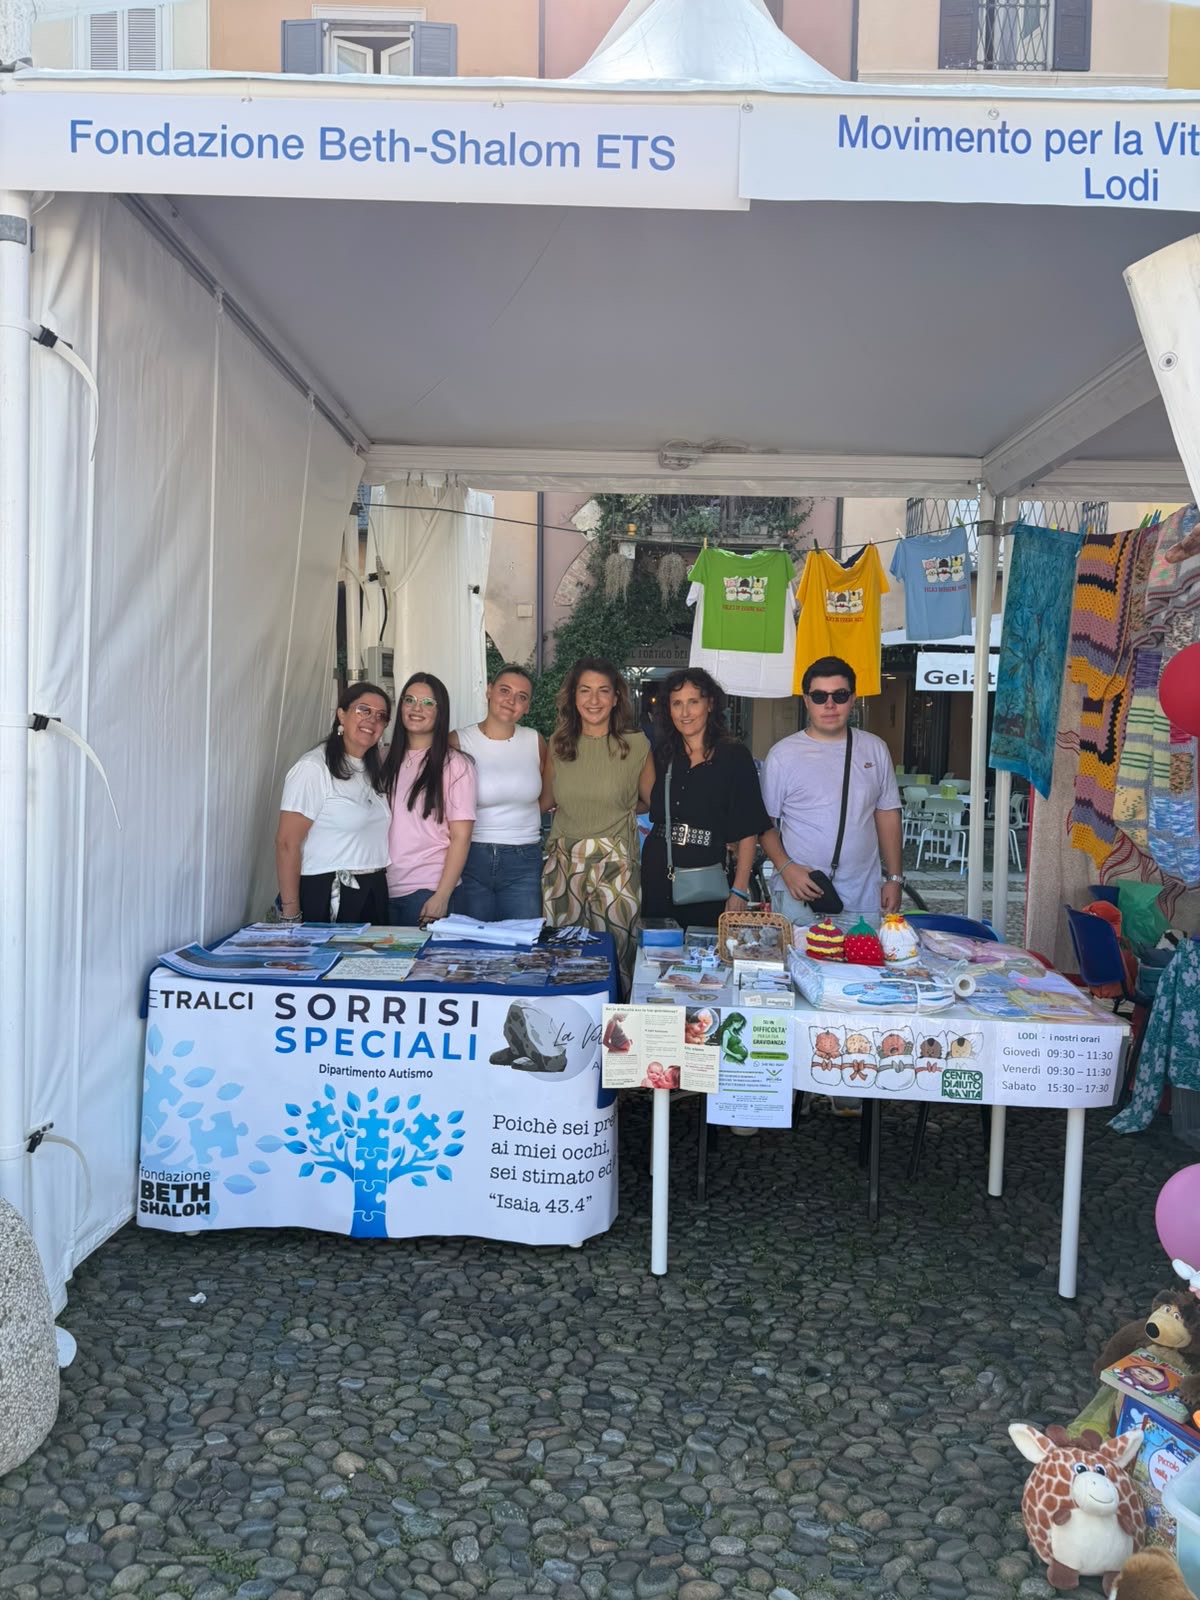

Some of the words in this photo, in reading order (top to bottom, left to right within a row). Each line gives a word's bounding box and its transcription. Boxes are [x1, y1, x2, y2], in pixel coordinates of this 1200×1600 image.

[69, 119, 305, 160] Fondazione
[319, 126, 581, 168] Beth-Shalom
[597, 134, 677, 171] ETS
[838, 113, 1032, 154] Movimento
[1044, 127, 1103, 162] per
[1113, 121, 1143, 156] la
[1084, 167, 1159, 202] Lodi
[923, 669, 996, 685] Gelt
[274, 992, 479, 1028] SORRISI
[274, 1026, 477, 1061] SPECIALI
[1017, 1032, 1038, 1041] LODI
[1054, 1034, 1079, 1042] nostri
[1080, 1035, 1101, 1044] orari
[1002, 1046, 1041, 1058] Giovedì
[1046, 1048, 1075, 1060] 09:30
[1086, 1051, 1114, 1061] 11:30
[318, 1063, 386, 1079] Dipartimento
[388, 1067, 434, 1079] Autismo
[944, 1071, 982, 1082] CENTRO
[1002, 1064, 1041, 1075] Venerdì
[1046, 1066, 1075, 1077] 09:30
[1085, 1067, 1112, 1077] 11:30
[1002, 1080, 1037, 1092] Sabato
[1047, 1083, 1075, 1093] 15:30
[1084, 1084, 1109, 1094] 17:30
[492, 1114, 557, 1135] Poichè
[562, 1120, 590, 1136] sei
[490, 1140, 509, 1155] ai
[513, 1142, 557, 1160] miei
[562, 1140, 610, 1161] occhi,
[140, 1166, 211, 1182] fondazione
[489, 1165, 517, 1181] sei
[522, 1167, 595, 1185] stimato
[140, 1179, 210, 1203] BETH
[140, 1199, 210, 1217] SHALOM
[488, 1192, 541, 1213] “Isaia
[544, 1195, 592, 1214] 43.4”
